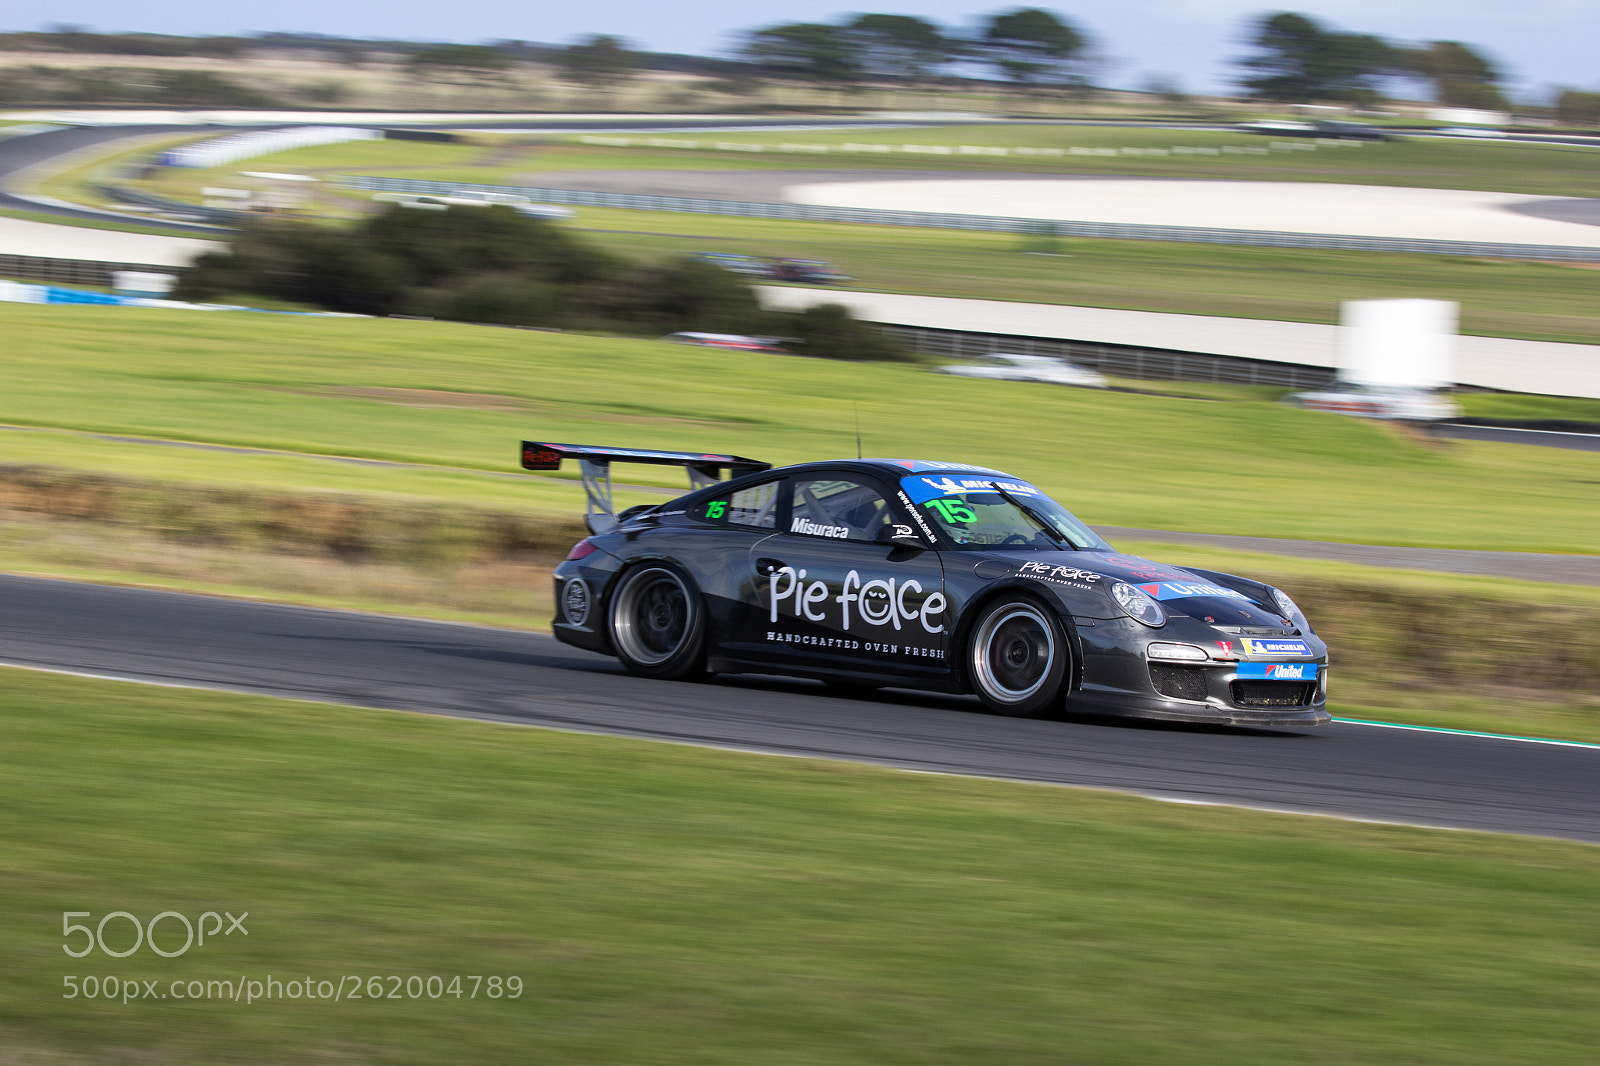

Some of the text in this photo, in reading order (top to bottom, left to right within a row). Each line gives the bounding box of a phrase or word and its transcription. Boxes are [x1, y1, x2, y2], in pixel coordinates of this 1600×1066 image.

[960, 480, 1039, 495] MICHELIN
[704, 501, 728, 519] 15
[896, 490, 938, 544] www.porsche.com.au
[924, 499, 978, 524] 15
[790, 517, 849, 539] Misuraca
[1018, 561, 1102, 583] Pie face
[767, 565, 947, 634] Pie face
[766, 631, 945, 660] HANDCRAFTED OVEN FRESH
[1266, 643, 1306, 651] MICHELIN
[1274, 664, 1304, 679] United
